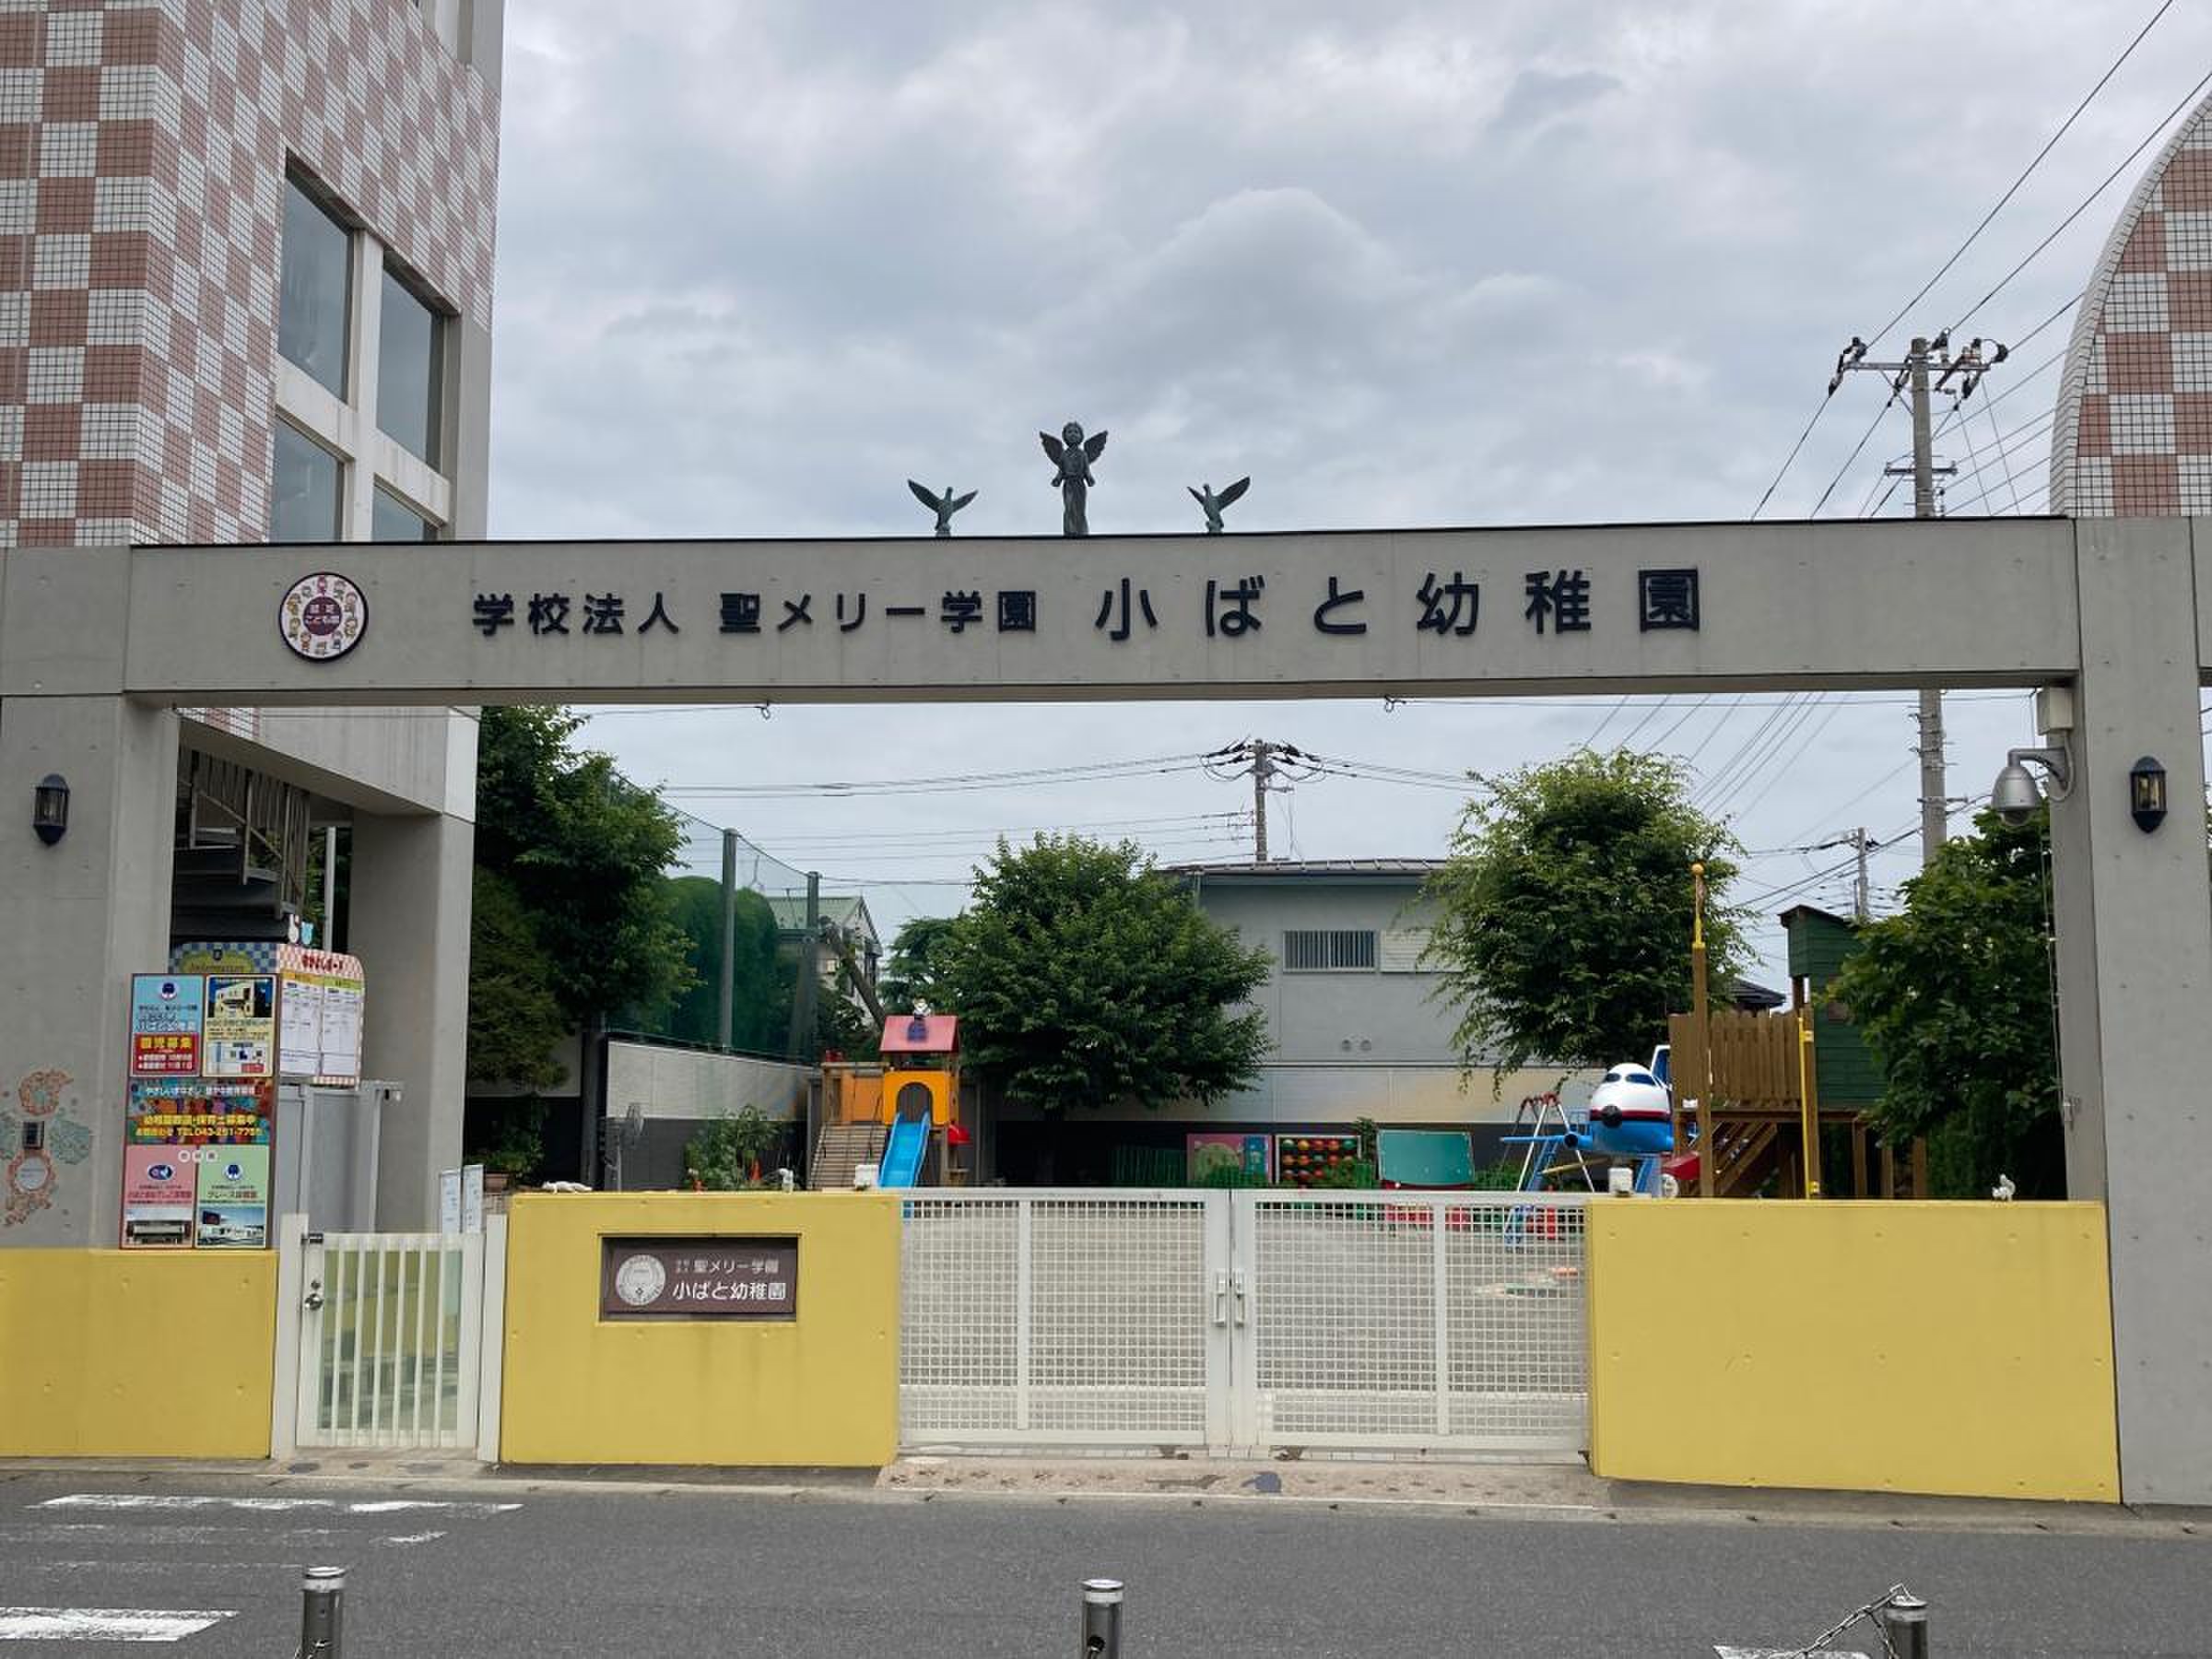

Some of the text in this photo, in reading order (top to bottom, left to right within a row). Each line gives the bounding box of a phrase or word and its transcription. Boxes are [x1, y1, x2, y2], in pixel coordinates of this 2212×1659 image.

[472, 568, 1700, 642] 学校法人 聖メリー学園 小ばと幼稚園
[672, 1280, 786, 1300] 小ばと幼稚園
